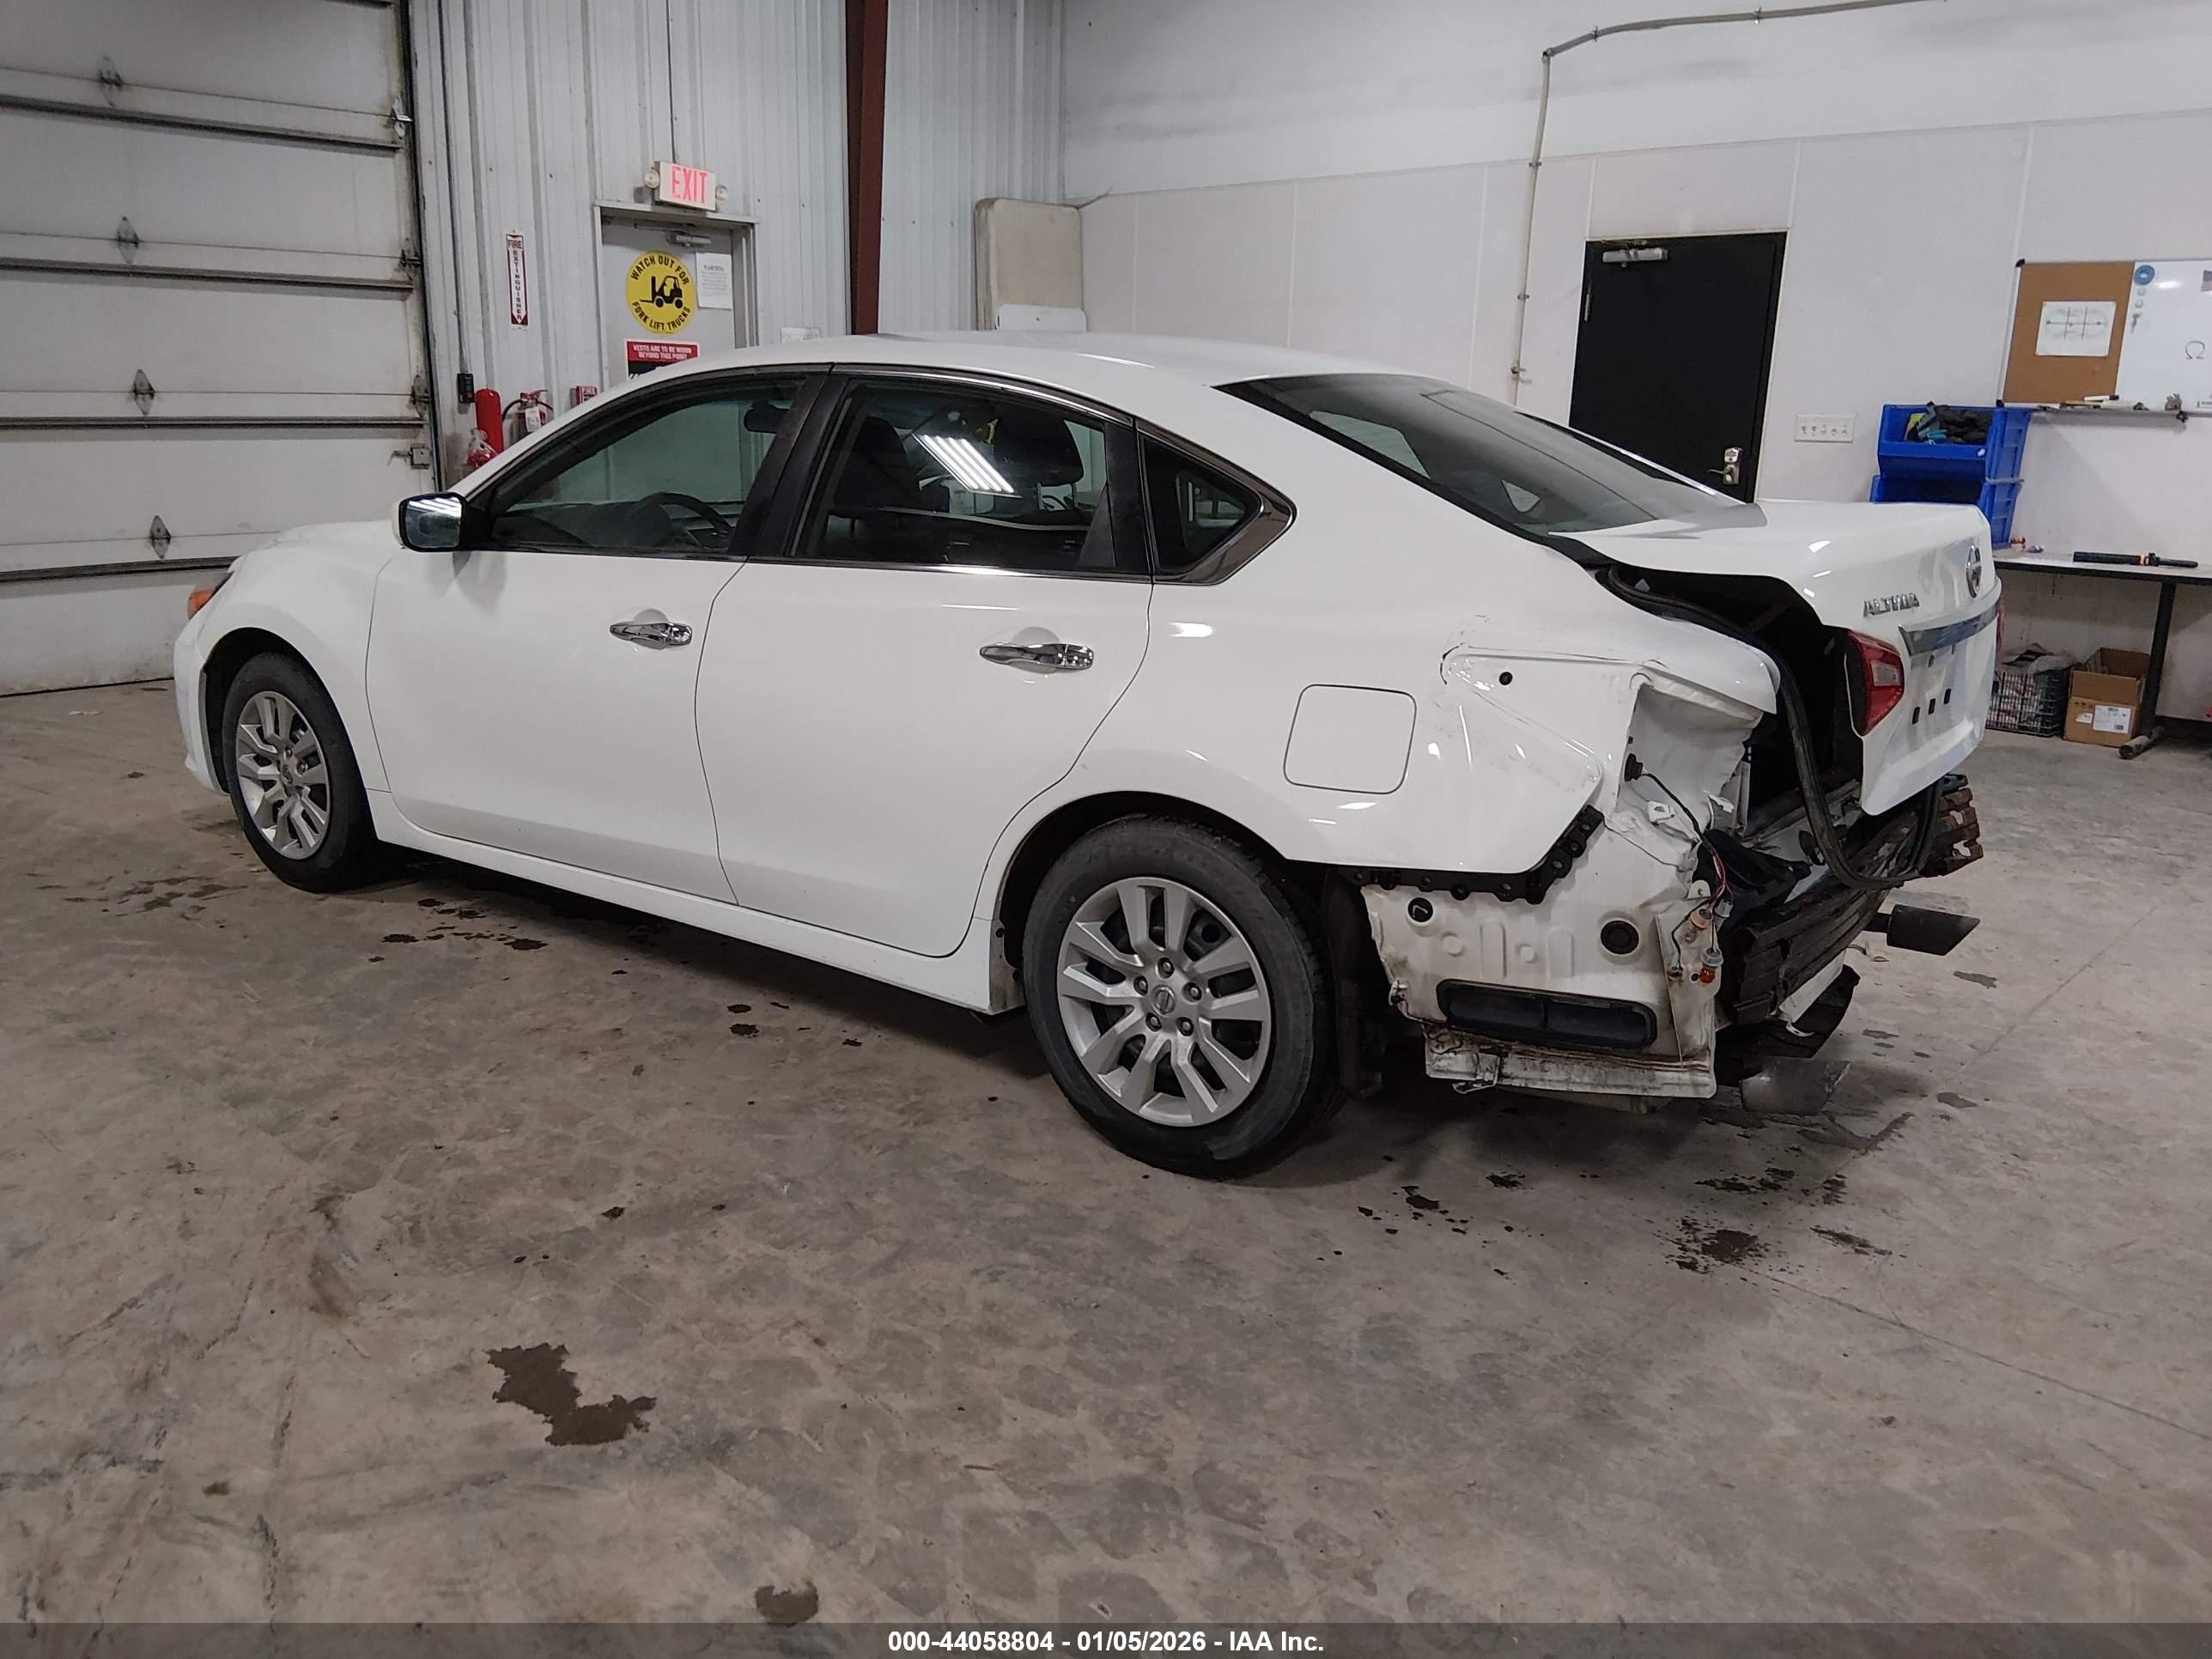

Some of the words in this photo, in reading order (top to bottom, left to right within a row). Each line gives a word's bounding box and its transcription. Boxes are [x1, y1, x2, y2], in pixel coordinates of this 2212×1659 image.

[672, 165, 708, 204] EXIT
[507, 240, 522, 249] FIRE
[513, 249, 522, 320] EXTINGUISHER
[631, 256, 655, 281] WATCH
[658, 255, 675, 268] OUT
[675, 265, 690, 285] FOR
[632, 301, 649, 323] FORK
[649, 319, 665, 331] LIFT
[667, 307, 690, 331] TRUCKS
